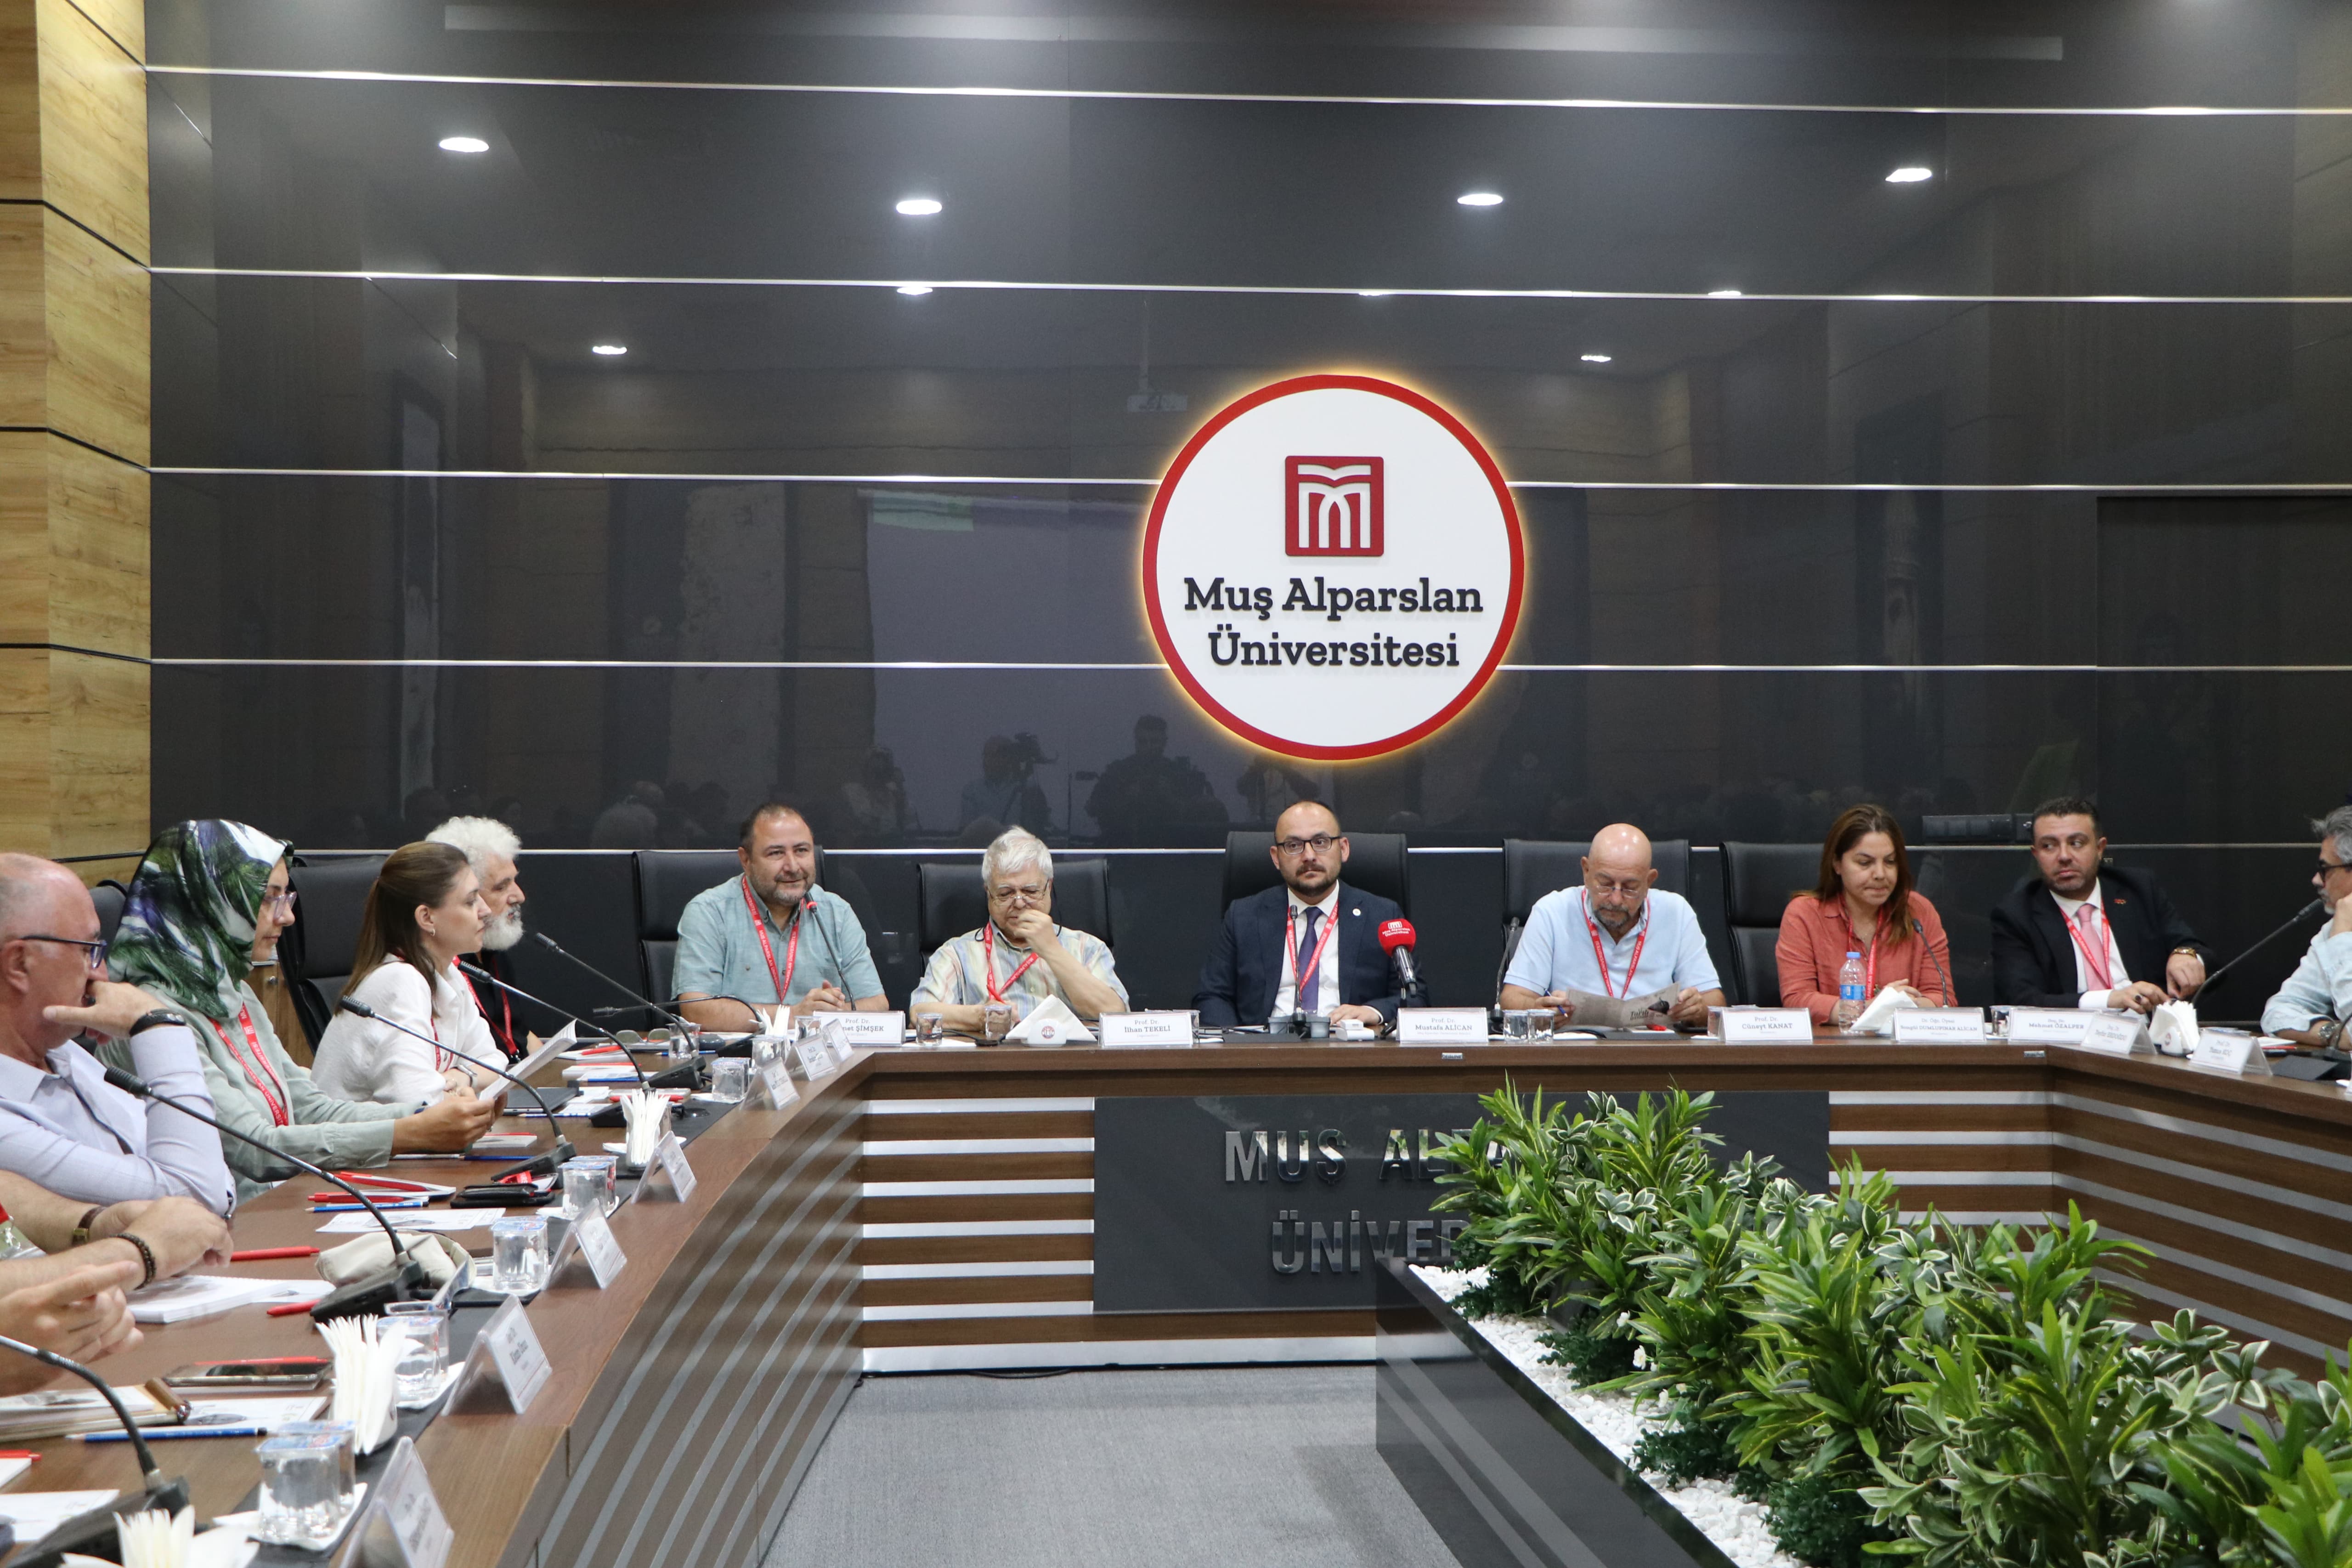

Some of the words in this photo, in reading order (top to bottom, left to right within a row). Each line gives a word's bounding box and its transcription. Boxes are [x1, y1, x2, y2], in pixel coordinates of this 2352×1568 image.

[1184, 577, 1273, 621] Muş
[1282, 577, 1483, 621] Alparslan
[1208, 623, 1459, 666] Üniversitesi
[265, 1092, 283, 1125] ÜNİVERSİT
[1225, 1129, 1347, 1184] MUŞ
